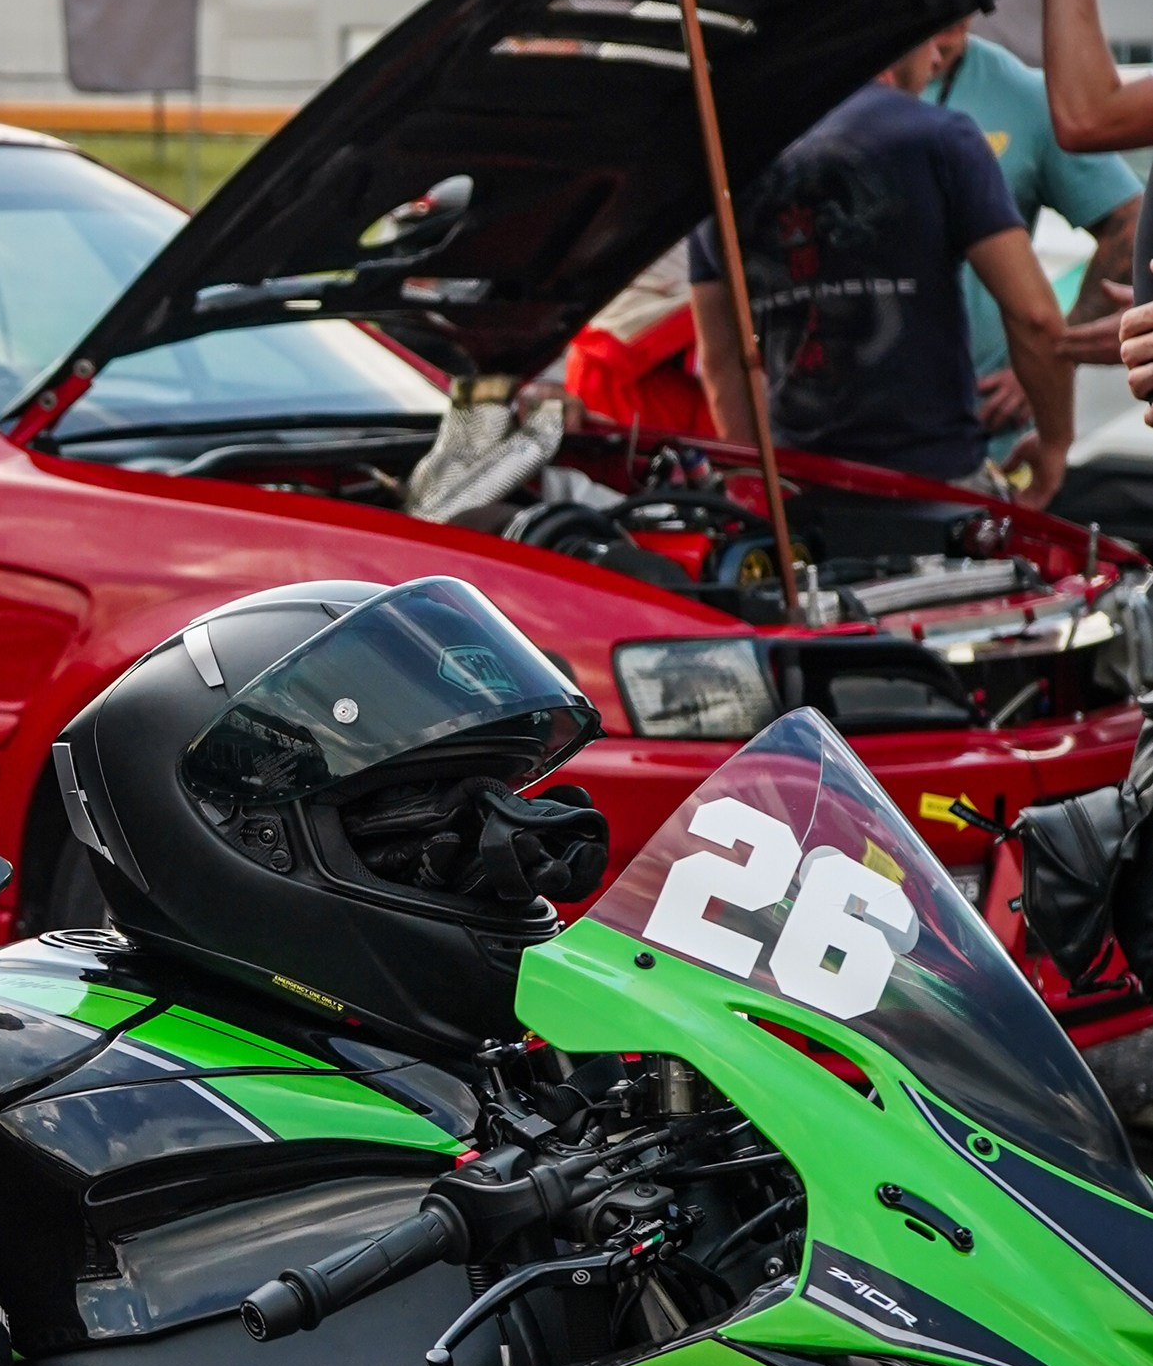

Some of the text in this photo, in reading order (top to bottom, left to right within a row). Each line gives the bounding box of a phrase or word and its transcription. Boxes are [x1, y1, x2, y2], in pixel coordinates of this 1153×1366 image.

[642, 796, 917, 1020] 26
[275, 975, 309, 994] EMERGENCY
[321, 996, 337, 1006] ONLY
